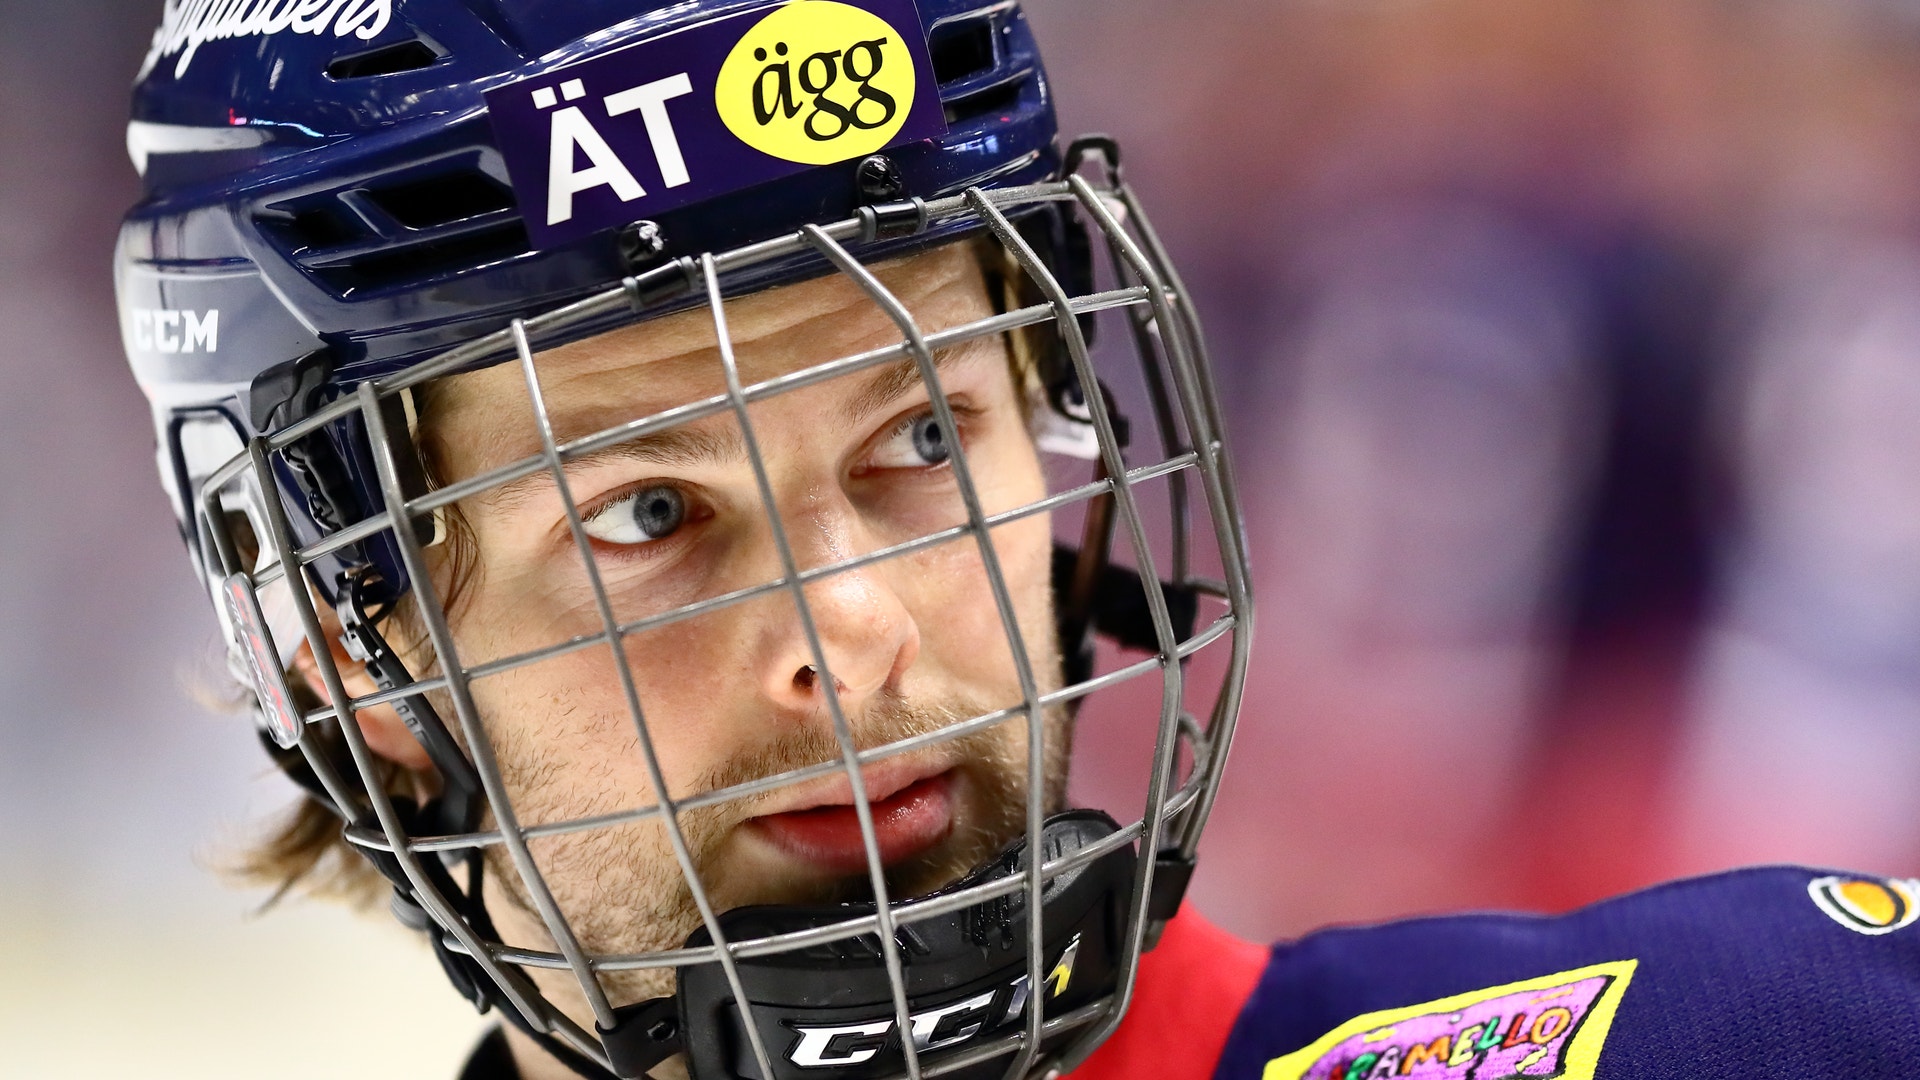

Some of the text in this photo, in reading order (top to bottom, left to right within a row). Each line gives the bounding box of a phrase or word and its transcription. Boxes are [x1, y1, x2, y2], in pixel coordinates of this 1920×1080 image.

[531, 37, 897, 226] ÄT ägg
[132, 308, 219, 353] CCM
